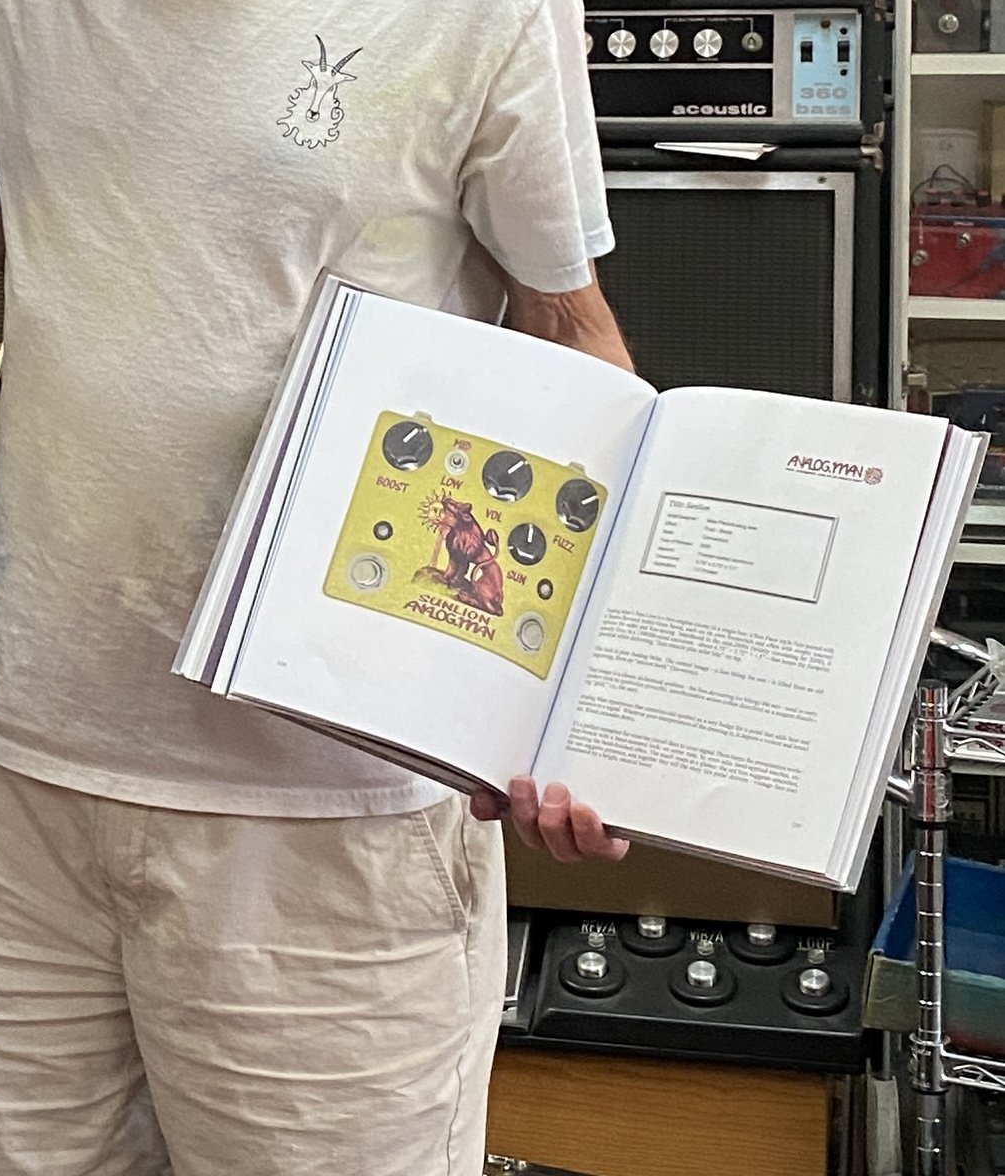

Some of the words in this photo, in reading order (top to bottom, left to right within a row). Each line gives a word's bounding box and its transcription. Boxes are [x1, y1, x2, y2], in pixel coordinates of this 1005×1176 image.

[672, 103, 767, 115] acoustic
[796, 103, 851, 114] bass
[376, 475, 410, 493] BOOST
[440, 475, 464, 490] LOW
[485, 507, 502, 523] VOL
[553, 534, 575, 554] FUZZ
[506, 570, 528, 586] SUN
[418, 594, 491, 625] SUNLION
